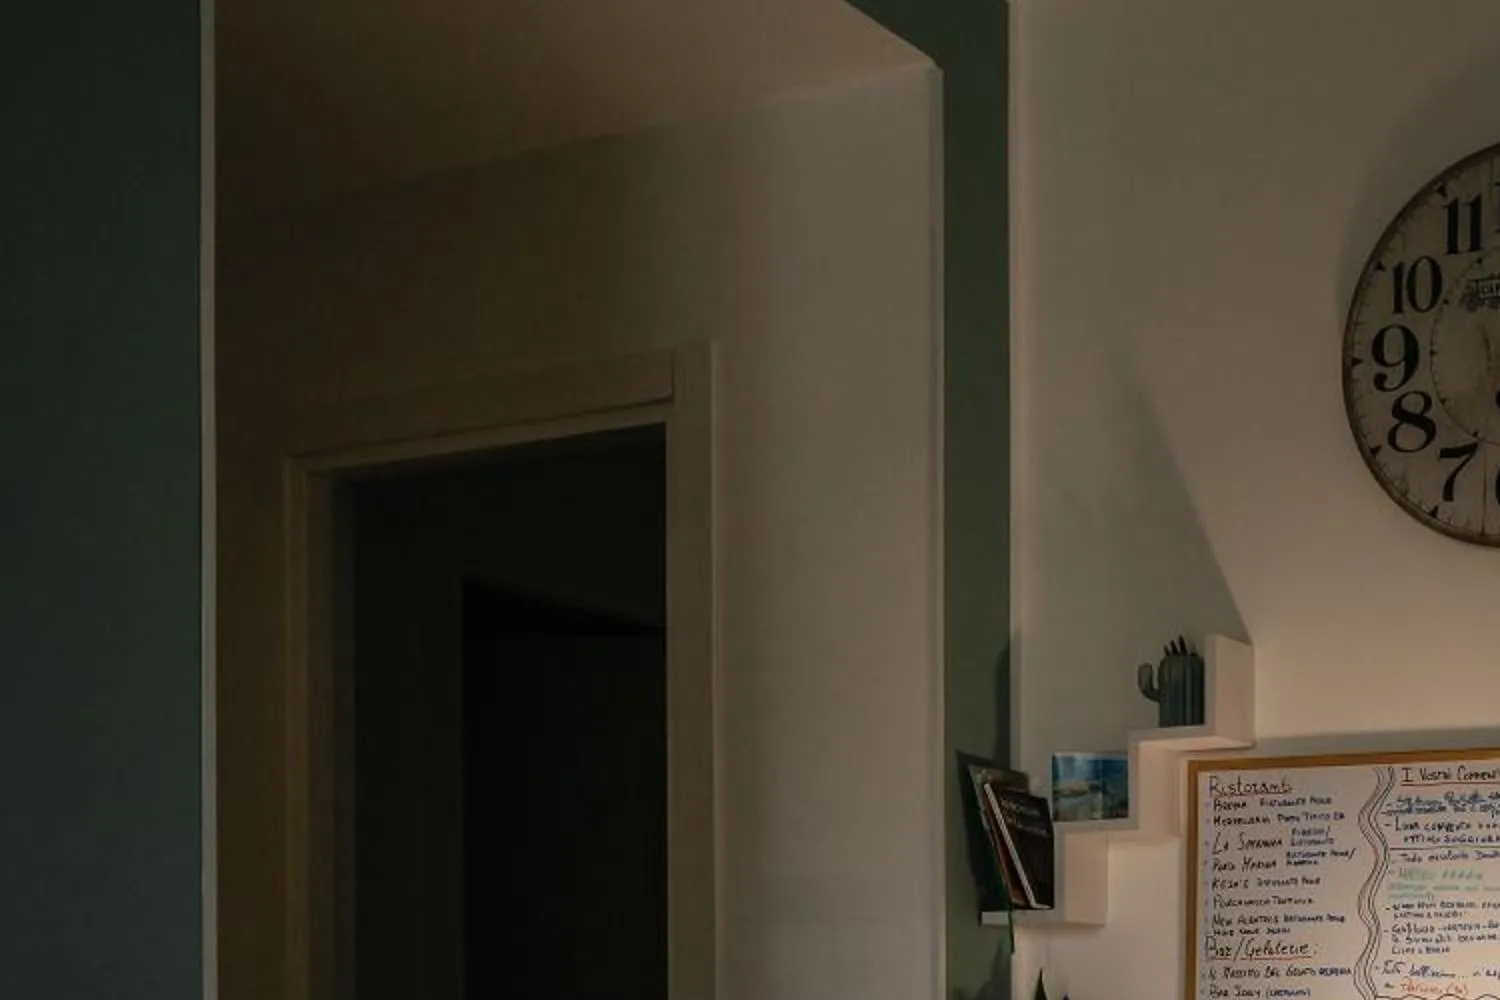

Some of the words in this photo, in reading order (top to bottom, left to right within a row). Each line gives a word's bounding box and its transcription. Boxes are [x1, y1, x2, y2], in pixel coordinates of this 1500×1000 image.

[1443, 193, 1483, 255] 11
[1390, 256, 1443, 315] 10
[1371, 323, 1420, 393] 9
[1387, 390, 1438, 454] 8
[1439, 442, 1478, 503] 7
